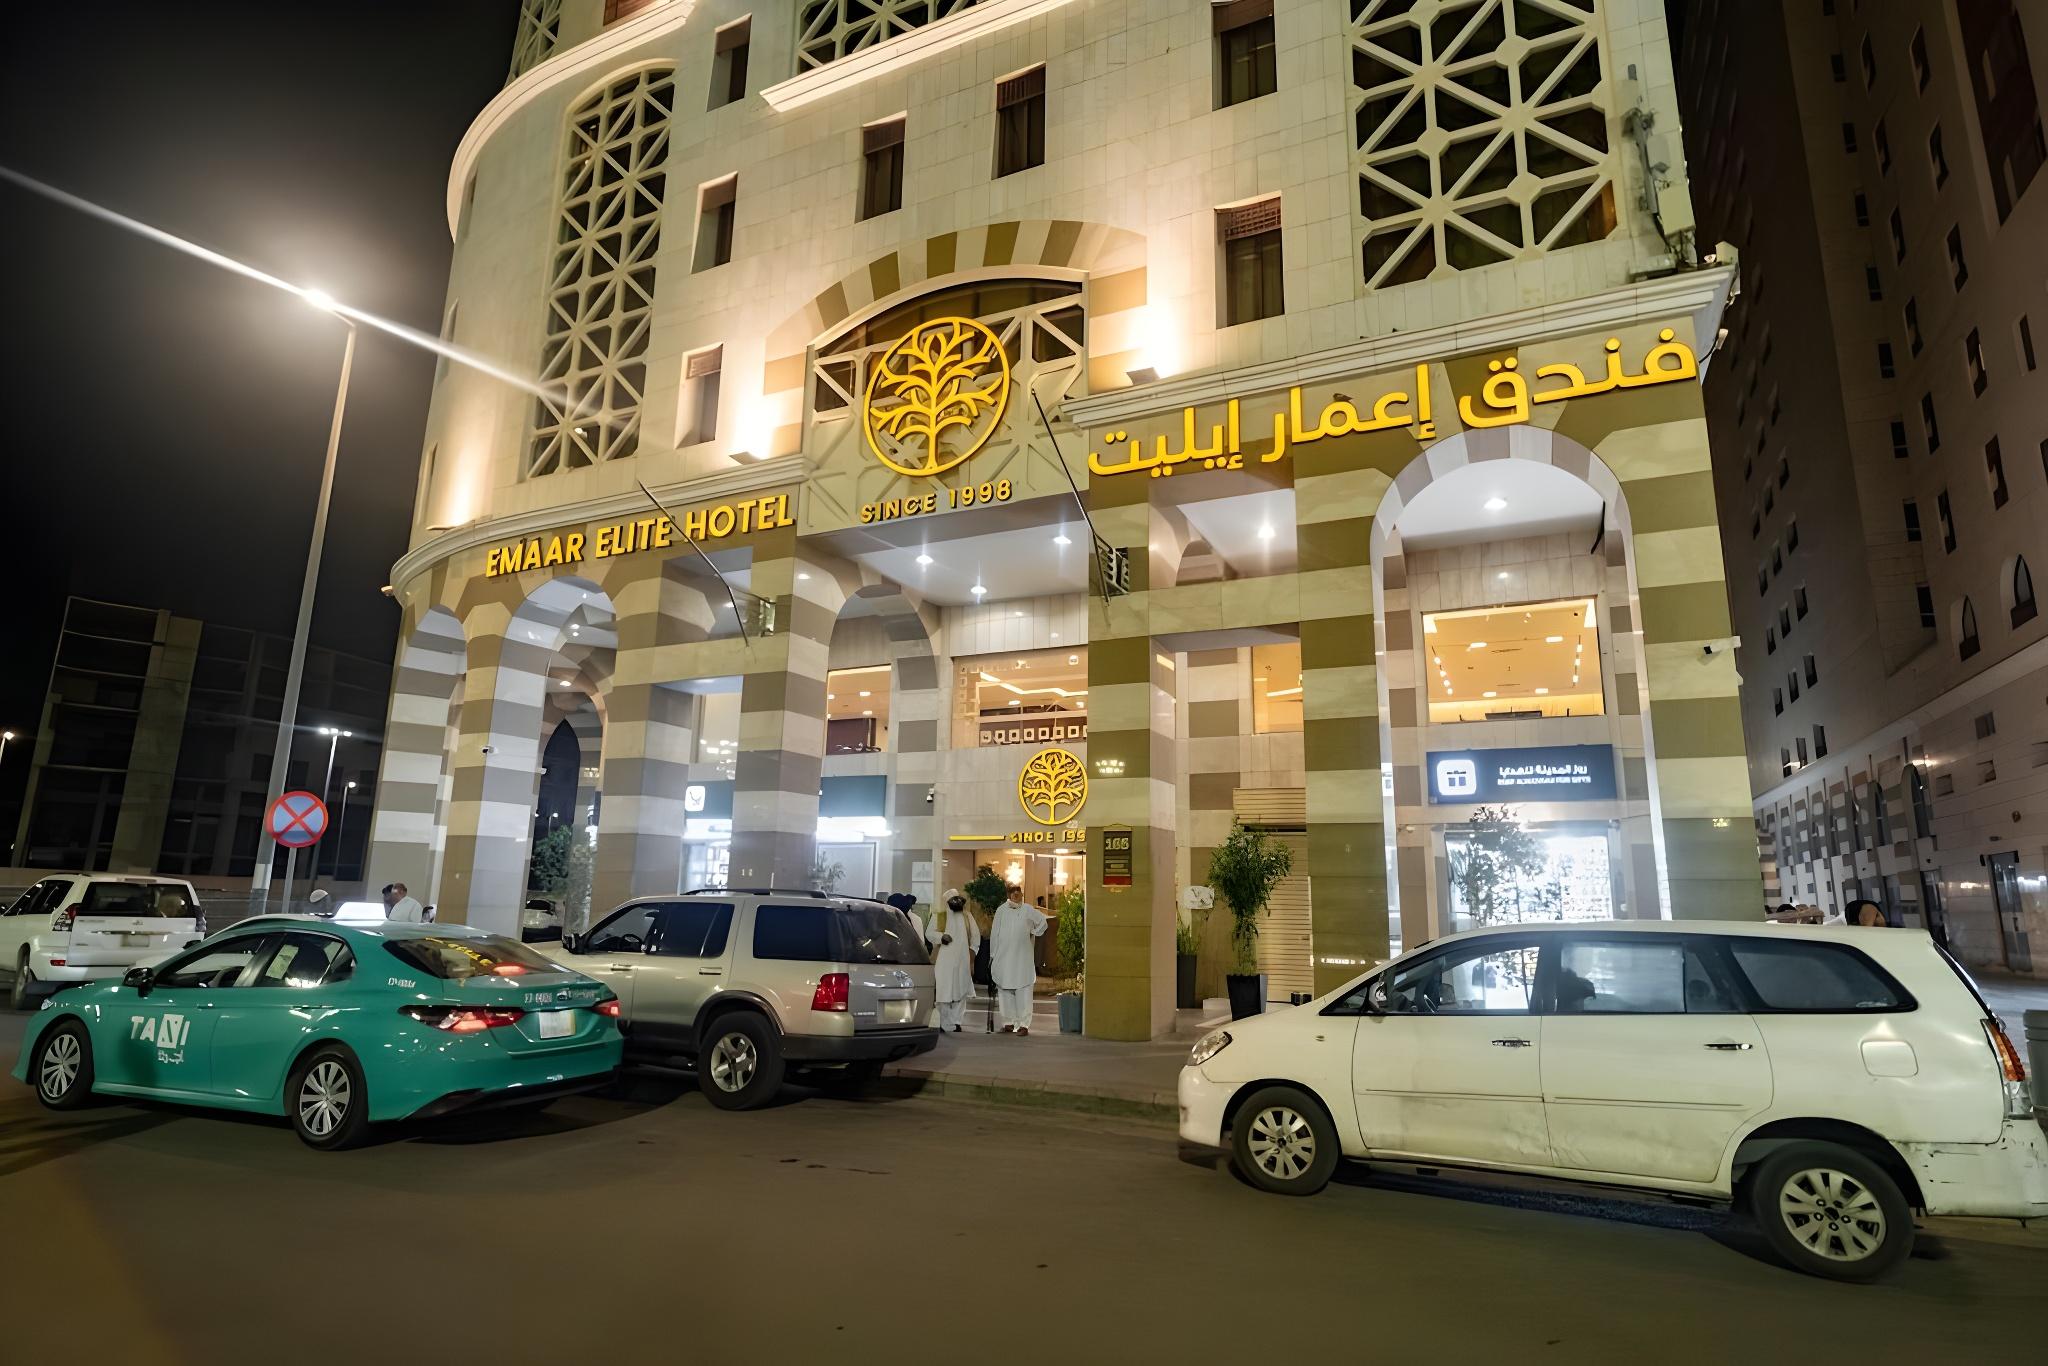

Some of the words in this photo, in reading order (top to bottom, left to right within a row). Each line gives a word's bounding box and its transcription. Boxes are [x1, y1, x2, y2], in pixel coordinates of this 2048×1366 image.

[1261, 363, 1437, 464] إعمار
[1458, 328, 1697, 428] فندق
[1088, 398, 1243, 478] إيليت
[485, 533, 586, 577] EMAAR
[595, 516, 675, 558] ELITE
[684, 494, 796, 543] HOTEL
[860, 493, 937, 524] SINCE
[949, 479, 1013, 509] 1998
